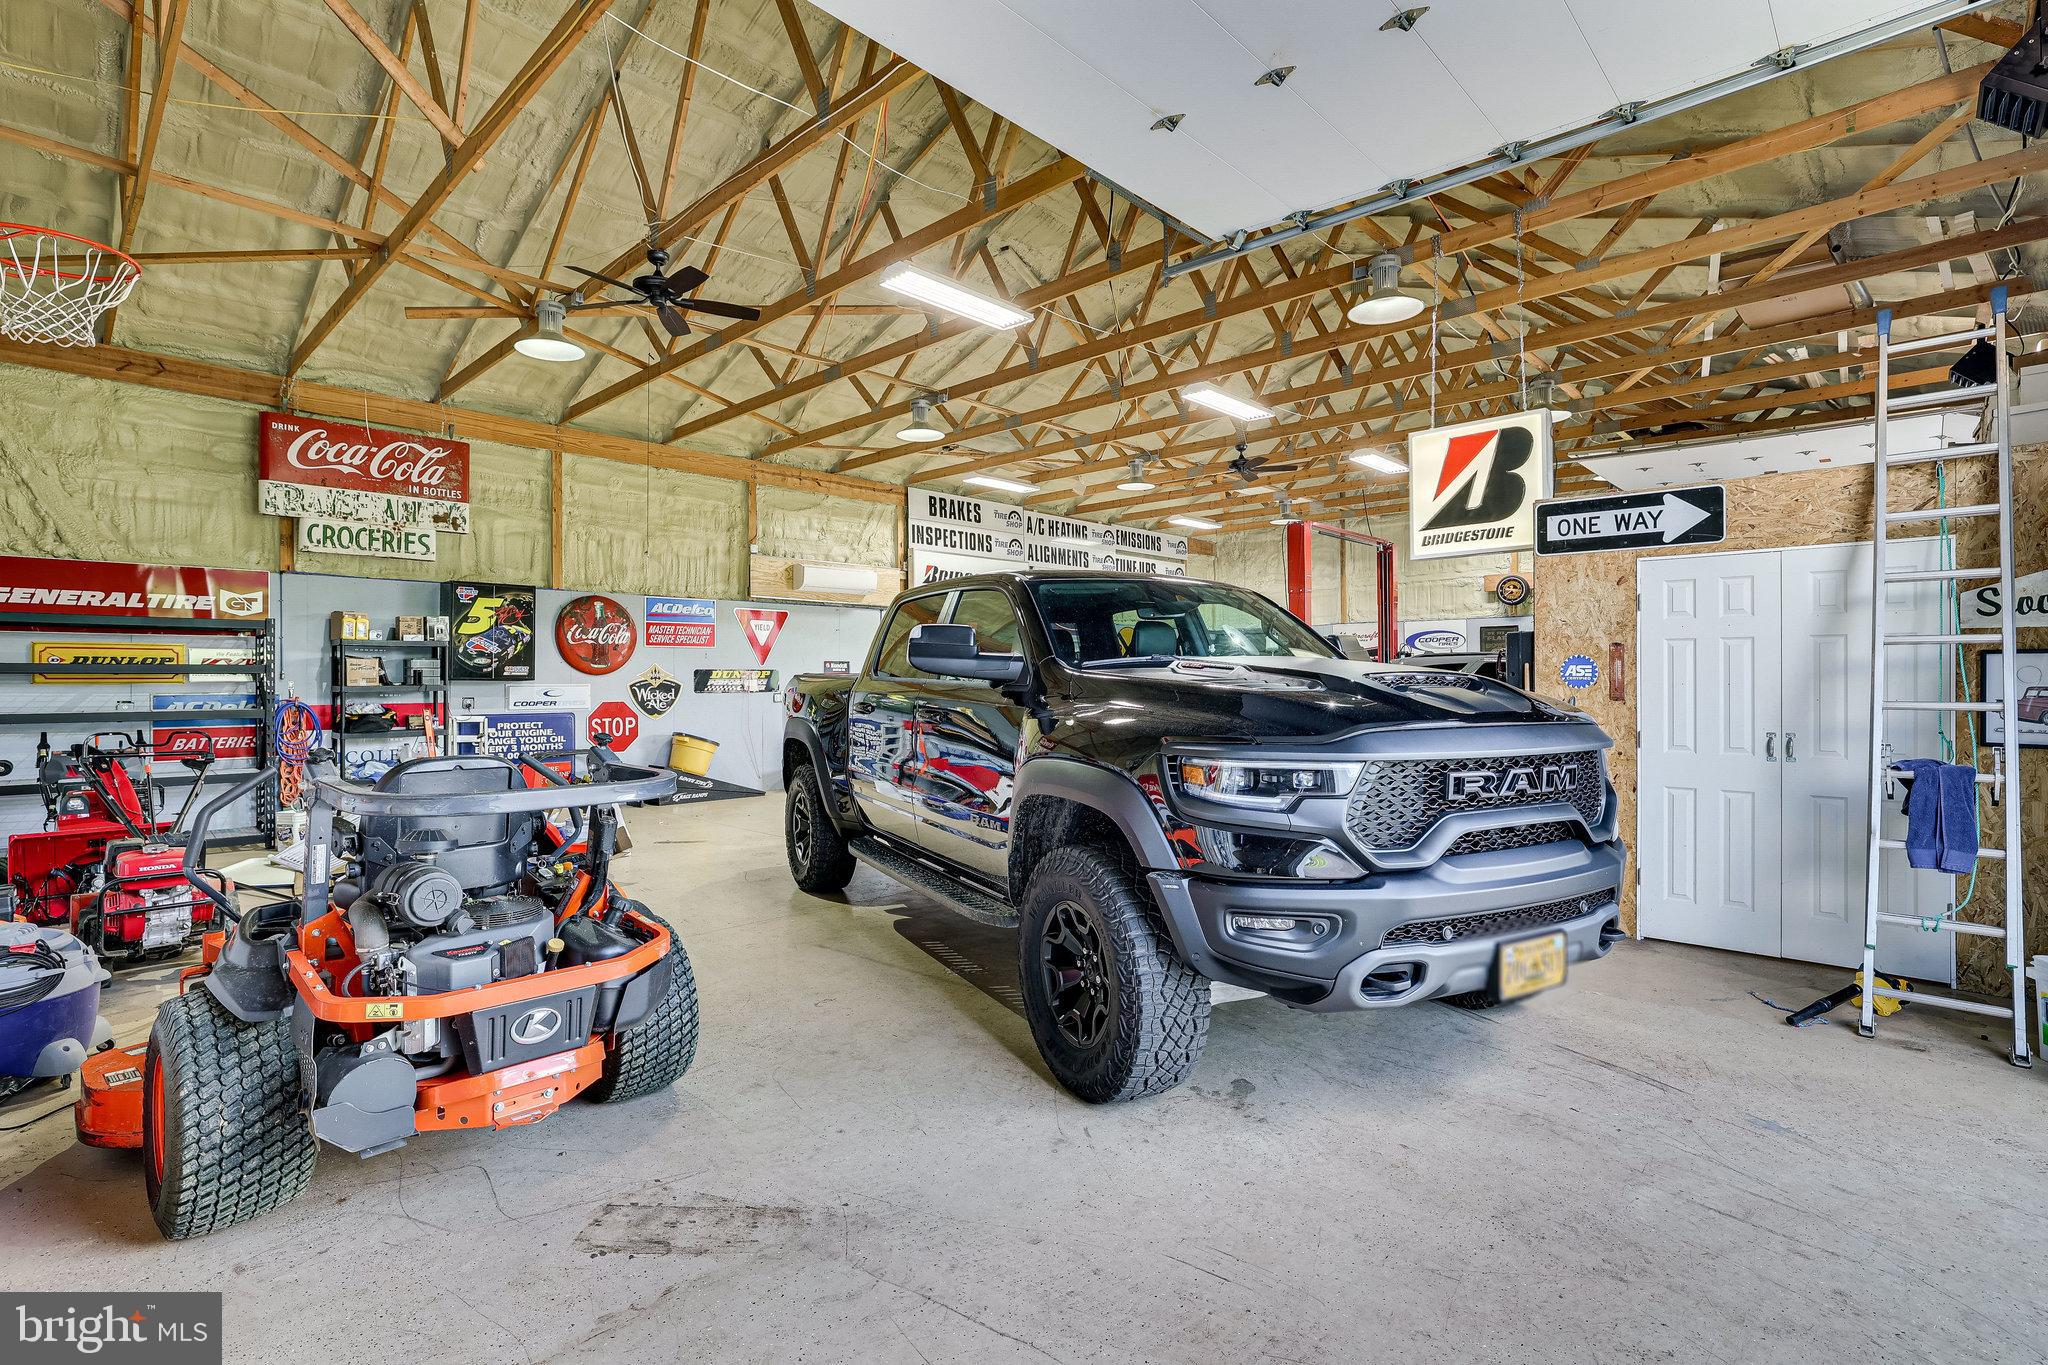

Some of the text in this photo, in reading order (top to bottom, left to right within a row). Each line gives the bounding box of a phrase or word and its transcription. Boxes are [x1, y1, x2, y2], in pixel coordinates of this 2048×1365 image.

[272, 422, 300, 432] DRINK
[287, 429, 452, 486] Coca-Cola
[408, 484, 462, 499] IN BOTTLES
[928, 495, 982, 524] BRAKES
[1006, 521, 1023, 529] SHOP
[1027, 515, 1088, 540] A/C HEATING
[1557, 508, 1666, 538] ONE WAY
[306, 523, 431, 555] GROCERIES
[911, 524, 993, 553] INSPECTIONS
[1115, 529, 1162, 552] EMISSIONS
[1421, 526, 1515, 547] BRIDGESTONE
[1028, 543, 1089, 568] ALIGNMENTS
[147, 594, 215, 610] TIRE
[650, 602, 714, 617] ACDelco
[457, 597, 504, 634] 5
[648, 625, 675, 635] MASTER
[754, 623, 770, 631] YIELD
[649, 635, 710, 644] SERVICE SPECIALIST
[1418, 636, 1460, 644] COOPER
[1564, 664, 1593, 676] ASE
[632, 685, 675, 702] Wicked
[645, 699, 670, 711] Ale
[497, 722, 543, 730] PROTECT
[515, 728, 556, 737] ENGINE.
[591, 717, 636, 737] STOP
[510, 744, 518, 752] 3
[520, 742, 564, 751] MONTHS
[518, 736, 547, 744] YOUR
[1446, 764, 1578, 800] RAM
